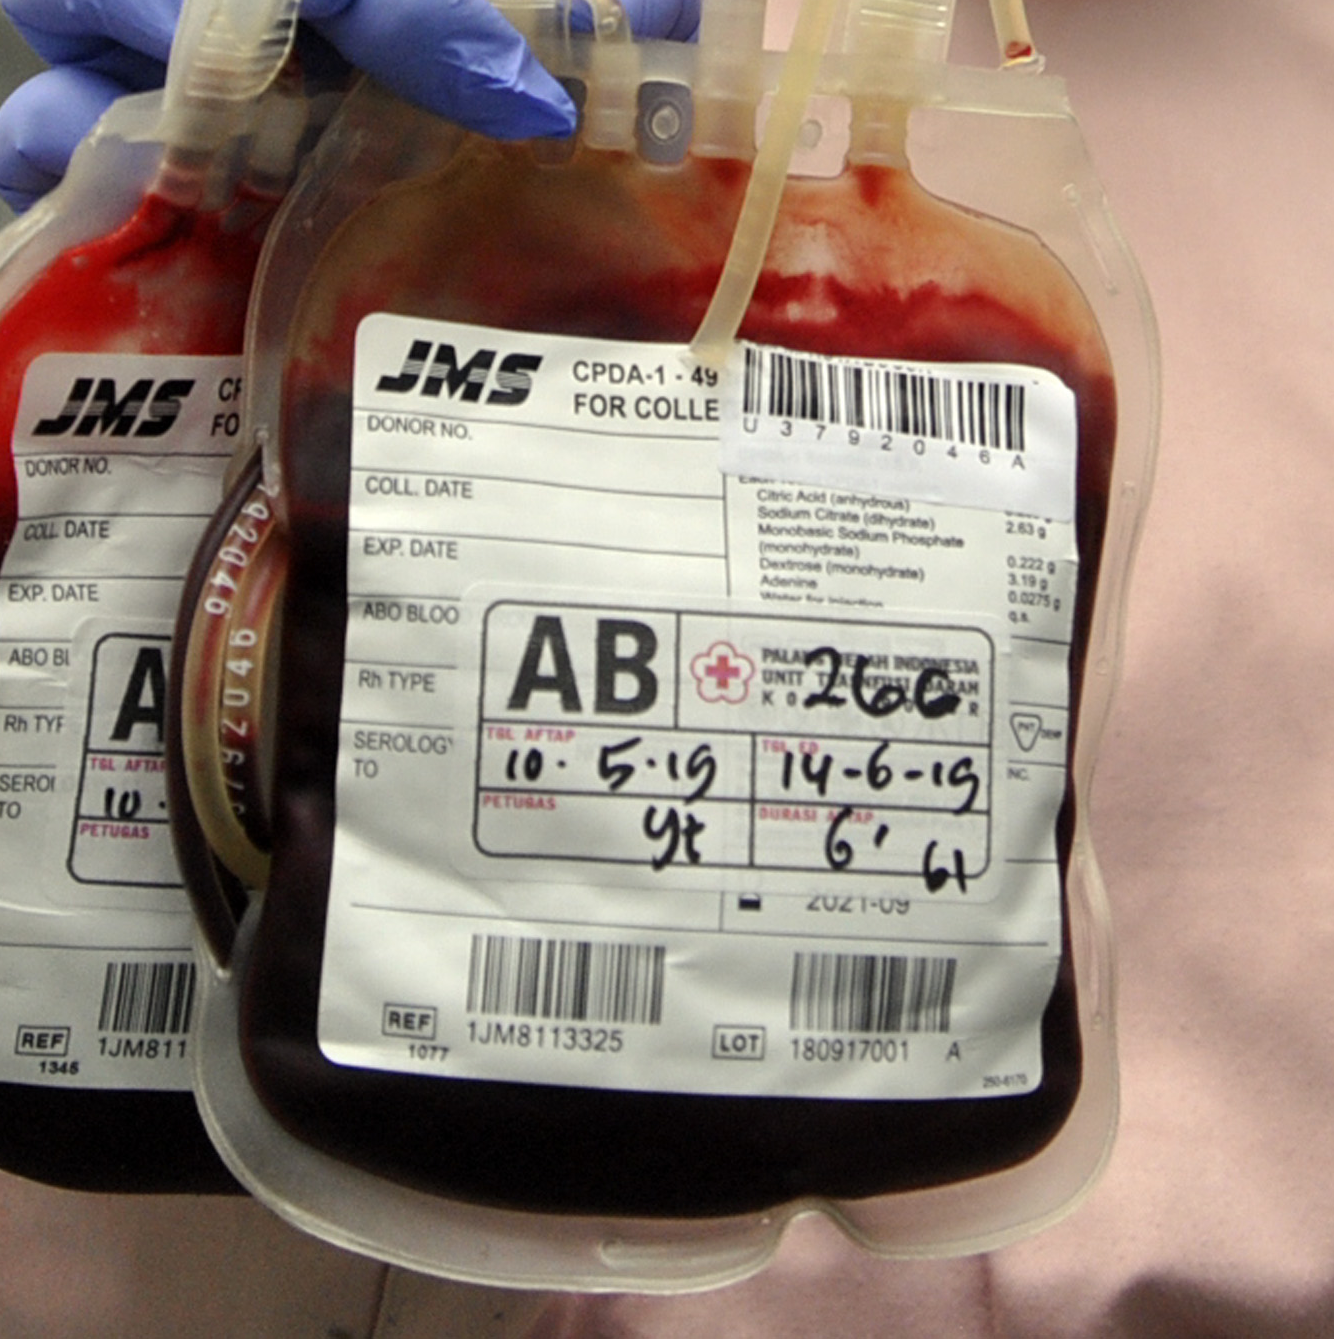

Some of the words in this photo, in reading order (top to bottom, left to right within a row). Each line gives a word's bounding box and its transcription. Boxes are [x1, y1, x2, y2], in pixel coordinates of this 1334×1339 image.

[375, 339, 544, 406] JMS
[573, 360, 665, 386] CPDA-1
[32, 378, 196, 437] JMS
[574, 394, 627, 419] FOR
[634, 396, 720, 421] COLLE
[367, 415, 436, 436] DONOR
[440, 422, 473, 441] NO.
[26, 458, 80, 478] DONOR
[83, 458, 112, 475] NO.
[365, 476, 419, 496] COLL.
[425, 479, 473, 499] DATE
[757, 489, 793, 504] Citric
[796, 490, 827, 505] Acid
[757, 507, 812, 521] Sodium
[815, 509, 860, 524] Citrate
[65, 520, 110, 539] DATE
[757, 524, 834, 540] Monobasic
[838, 528, 889, 543] Sodium
[892, 532, 965, 550] Phosphate
[363, 537, 404, 556] EXP.
[410, 539, 458, 559] DATE
[759, 558, 823, 573] Dextrose
[760, 575, 818, 590] Adenine
[8, 584, 46, 602] EXP.
[52, 584, 99, 602] DATE
[362, 602, 402, 622] ABO
[407, 604, 459, 624] BLOO
[7, 648, 47, 666] ABO
[507, 615, 658, 716] AB
[358, 670, 382, 689] Rh
[388, 671, 436, 693] TYPE
[762, 670, 804, 687] UNIT
[4, 714, 27, 732] Rh
[524, 729, 576, 742] AFTAP
[354, 759, 378, 779] TO
[483, 795, 556, 810] PETUGAS
[80, 823, 150, 839] PETUGAS
[388, 1011, 432, 1031] REF
[21, 1033, 64, 1049] REF
[467, 1021, 624, 1053] 1JM8113325
[720, 1034, 760, 1053] LOT
[98, 1037, 187, 1059] 1JM811
[408, 1044, 450, 1061] 1077
[791, 1038, 908, 1063] 180917001
[946, 1042, 961, 1061] A
